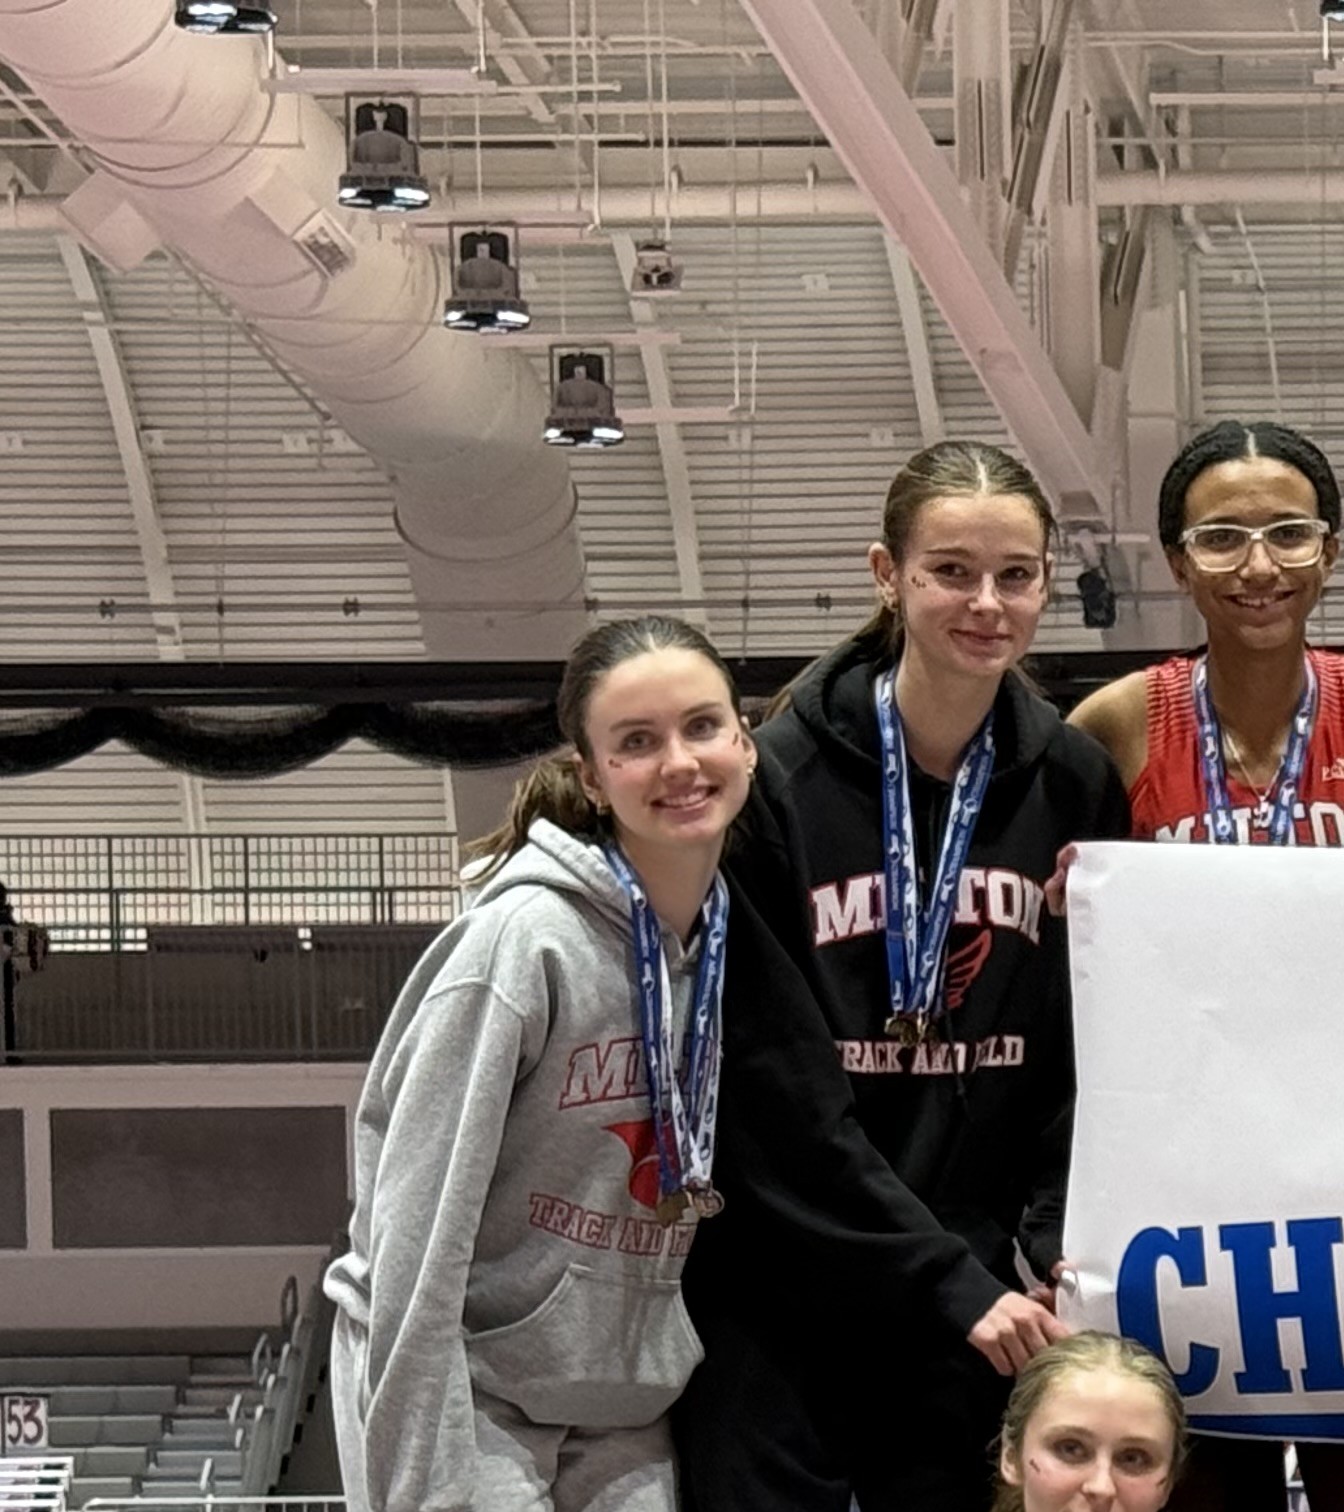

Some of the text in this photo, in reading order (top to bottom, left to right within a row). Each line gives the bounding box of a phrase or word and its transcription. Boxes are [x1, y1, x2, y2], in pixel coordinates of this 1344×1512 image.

[809, 866, 1045, 950] MITON
[834, 1040, 904, 1074] RACK
[7, 1399, 44, 1446] 53
